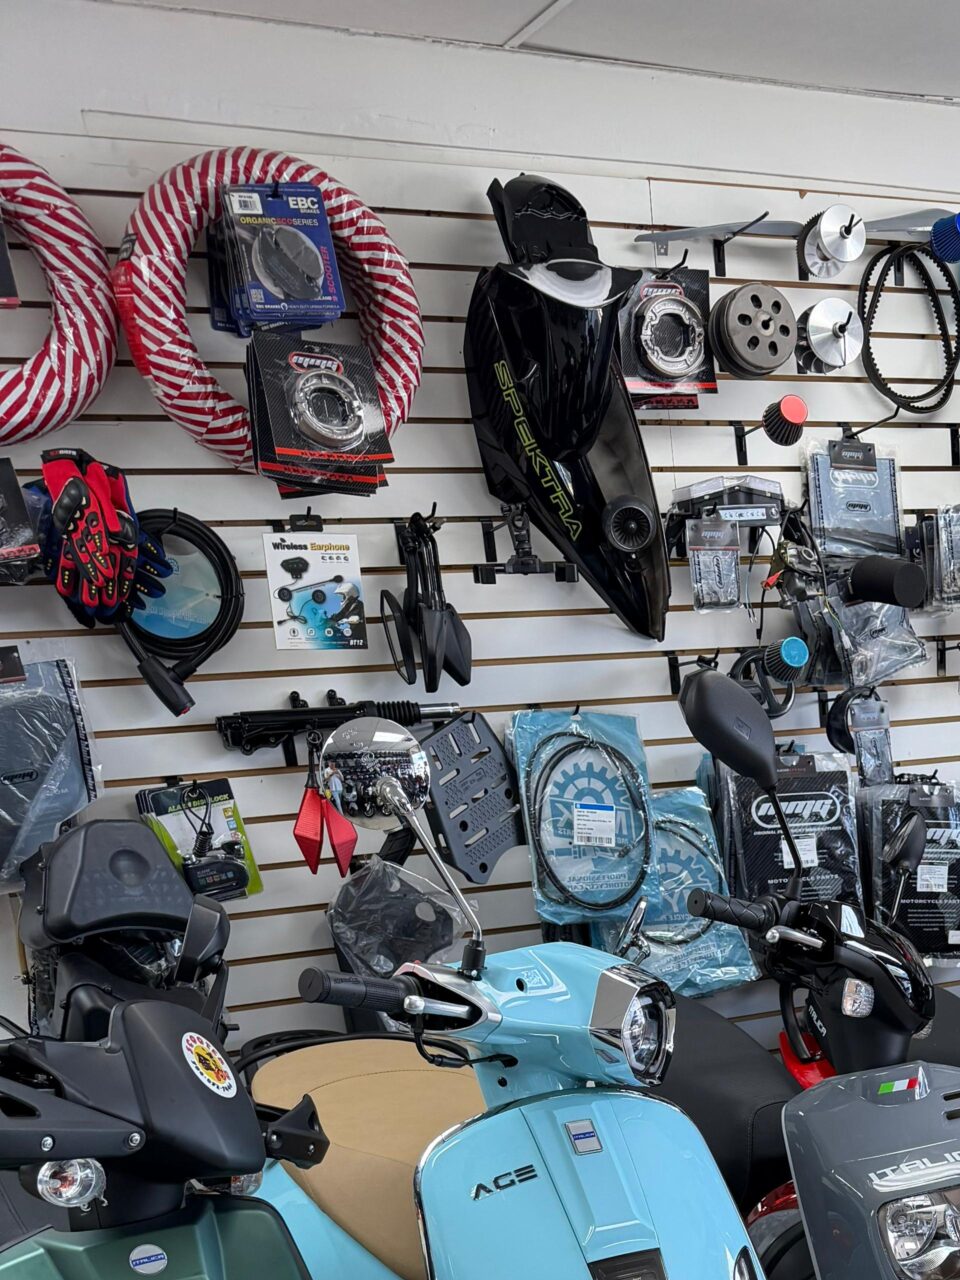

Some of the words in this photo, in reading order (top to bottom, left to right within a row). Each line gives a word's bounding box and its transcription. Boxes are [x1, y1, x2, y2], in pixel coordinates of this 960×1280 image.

[288, 197, 319, 209] EBC
[240, 216, 277, 225] ORGANIC
[293, 218, 319, 226] SERIES
[320, 246, 337, 293] SCOOTER
[494, 359, 583, 543] SPEKTRA
[272, 540, 309, 551] Wireless
[310, 543, 350, 552] Earphone
[130, 1253, 166, 1268] ITALICA
